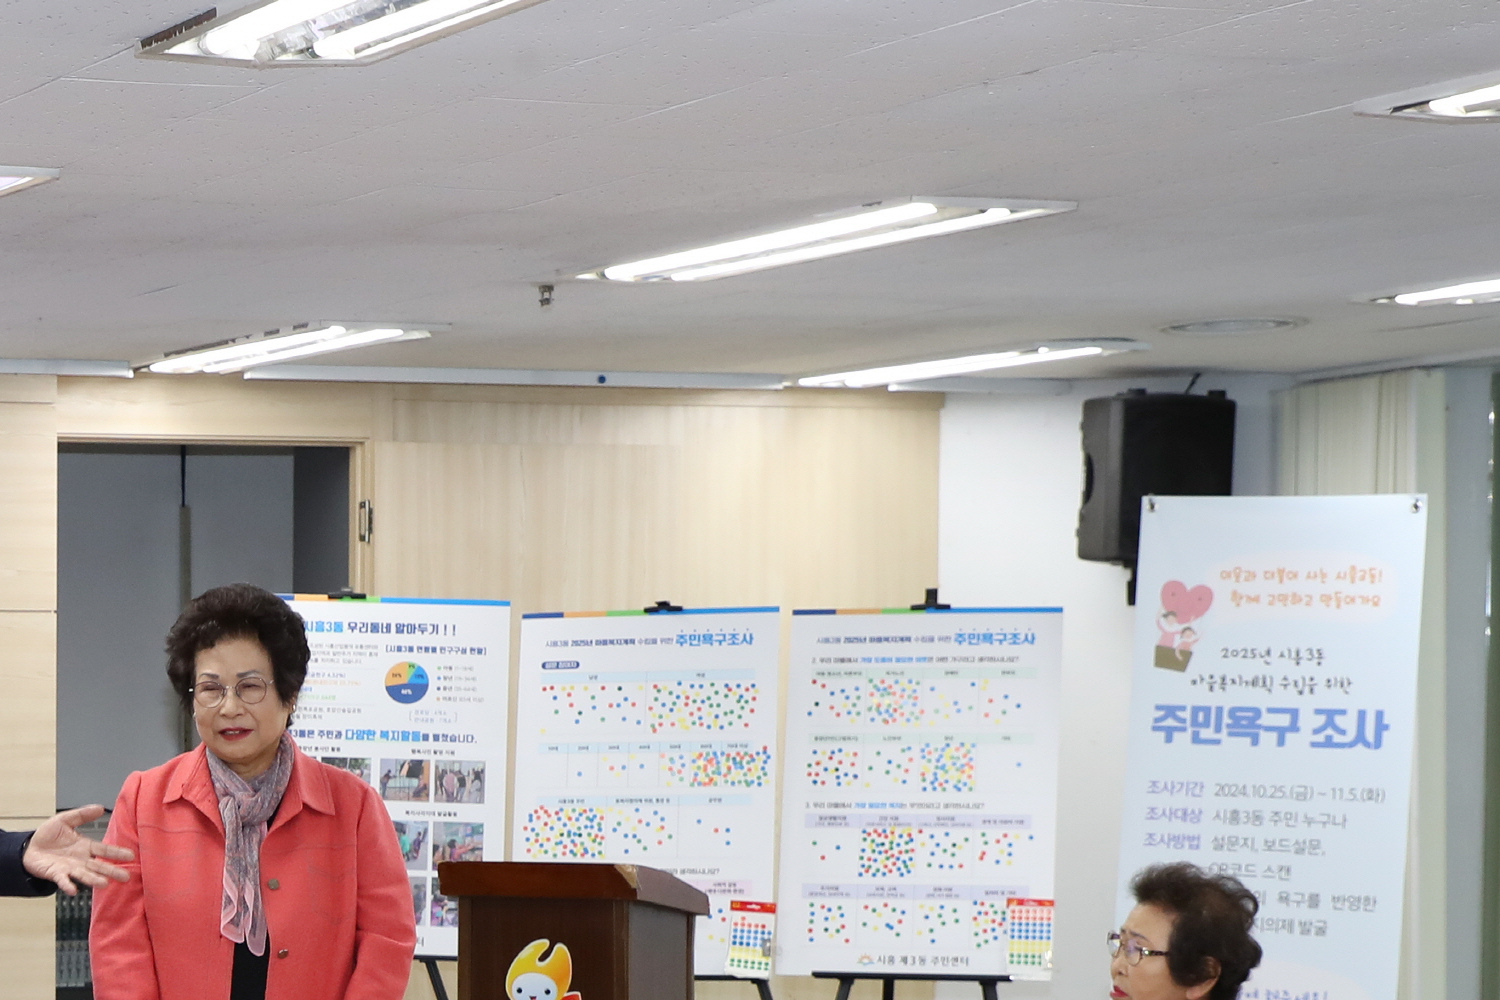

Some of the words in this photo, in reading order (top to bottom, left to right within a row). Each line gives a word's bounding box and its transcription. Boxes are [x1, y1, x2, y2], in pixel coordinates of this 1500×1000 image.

[675, 633, 754, 647] 주민욕구조사
[954, 632, 1036, 645] 주민욕구조사
[1221, 648, 1271, 665] 2025년
[1151, 704, 1300, 747] 주민욕구
[1309, 708, 1390, 750] 조사
[1146, 780, 1204, 798] 조사기간
[1145, 807, 1202, 824] 조사대상
[1212, 809, 1264, 827] 시흥3동
[1268, 811, 1299, 828] 주민
[1302, 813, 1347, 829] 누구나
[1143, 832, 1201, 850] 조사방법
[1263, 865, 1292, 881] 스캔
[1253, 918, 1294, 934] 지의제
